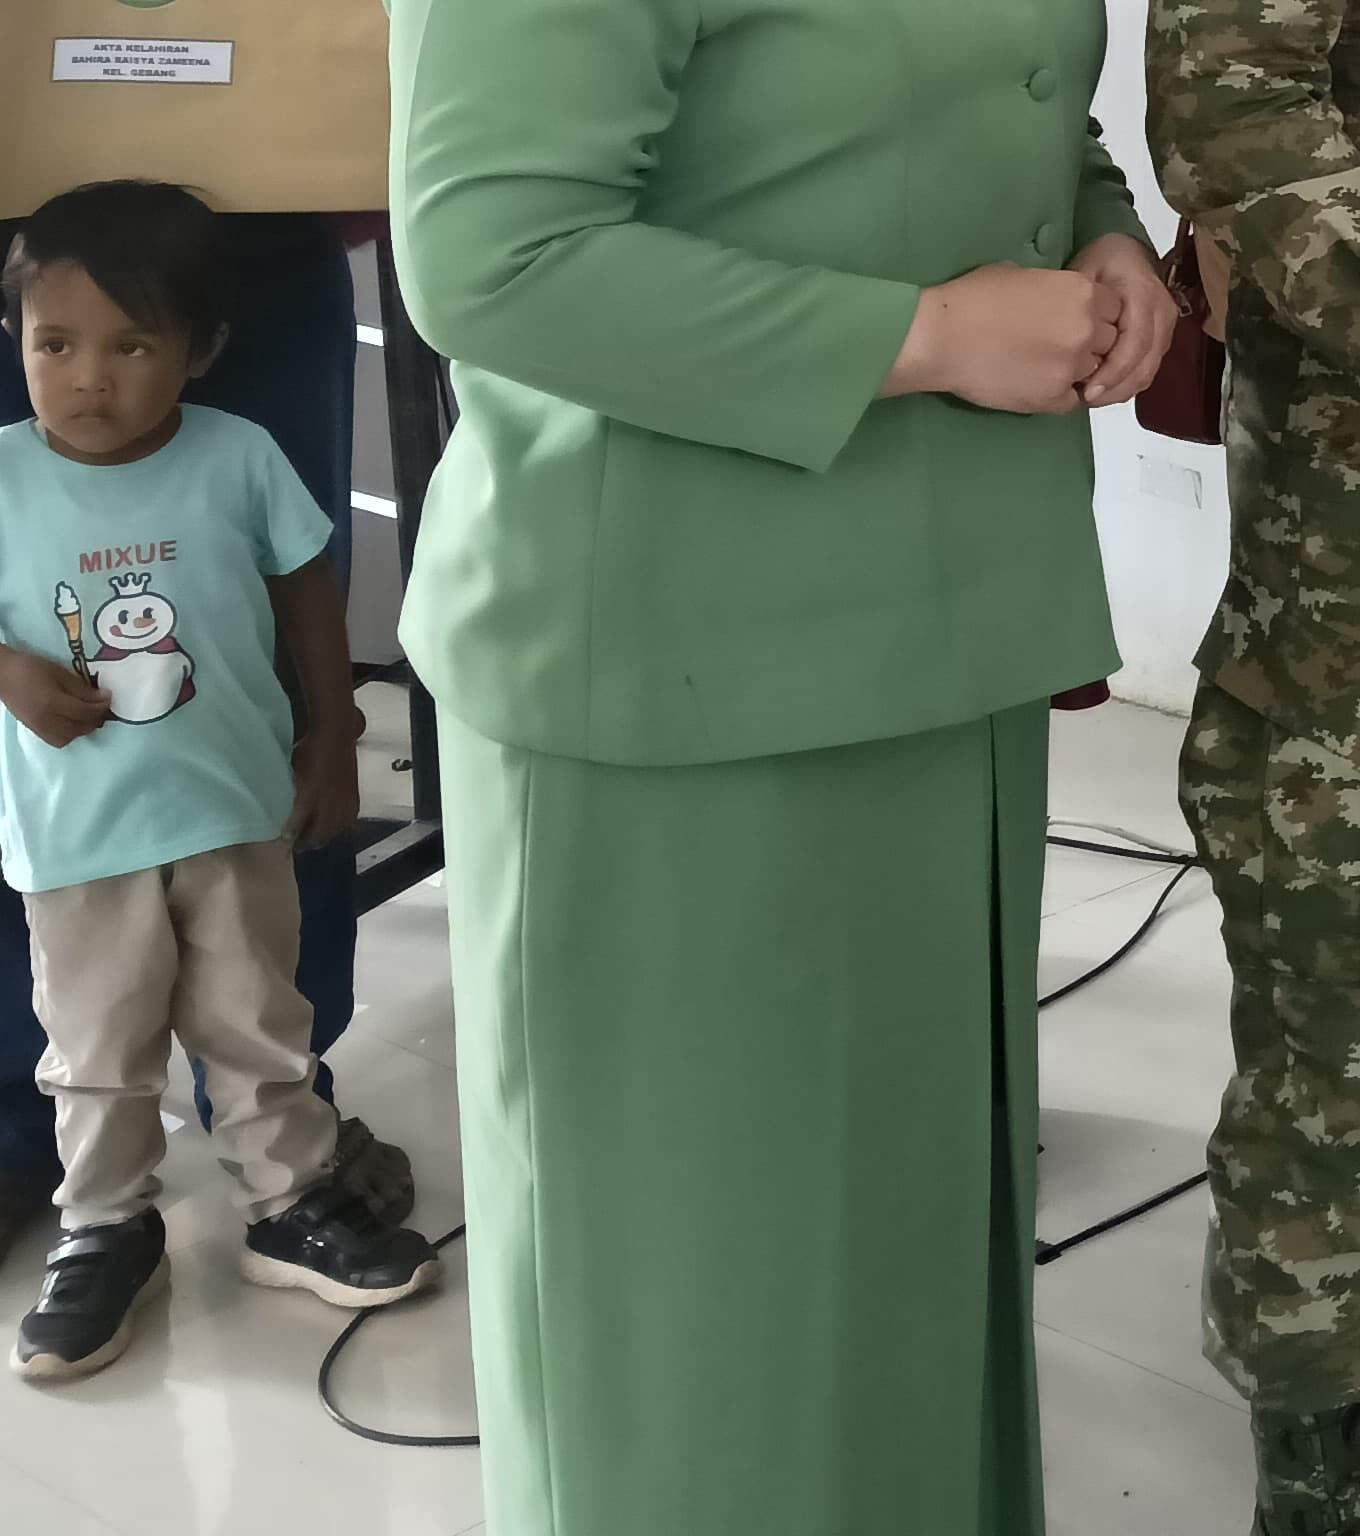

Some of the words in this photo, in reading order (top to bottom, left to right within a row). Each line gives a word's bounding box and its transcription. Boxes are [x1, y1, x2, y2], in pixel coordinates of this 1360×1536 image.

[93, 43, 122, 52] AKTA
[125, 44, 189, 53] KELAHIRAN
[79, 539, 178, 574] MIXUE
